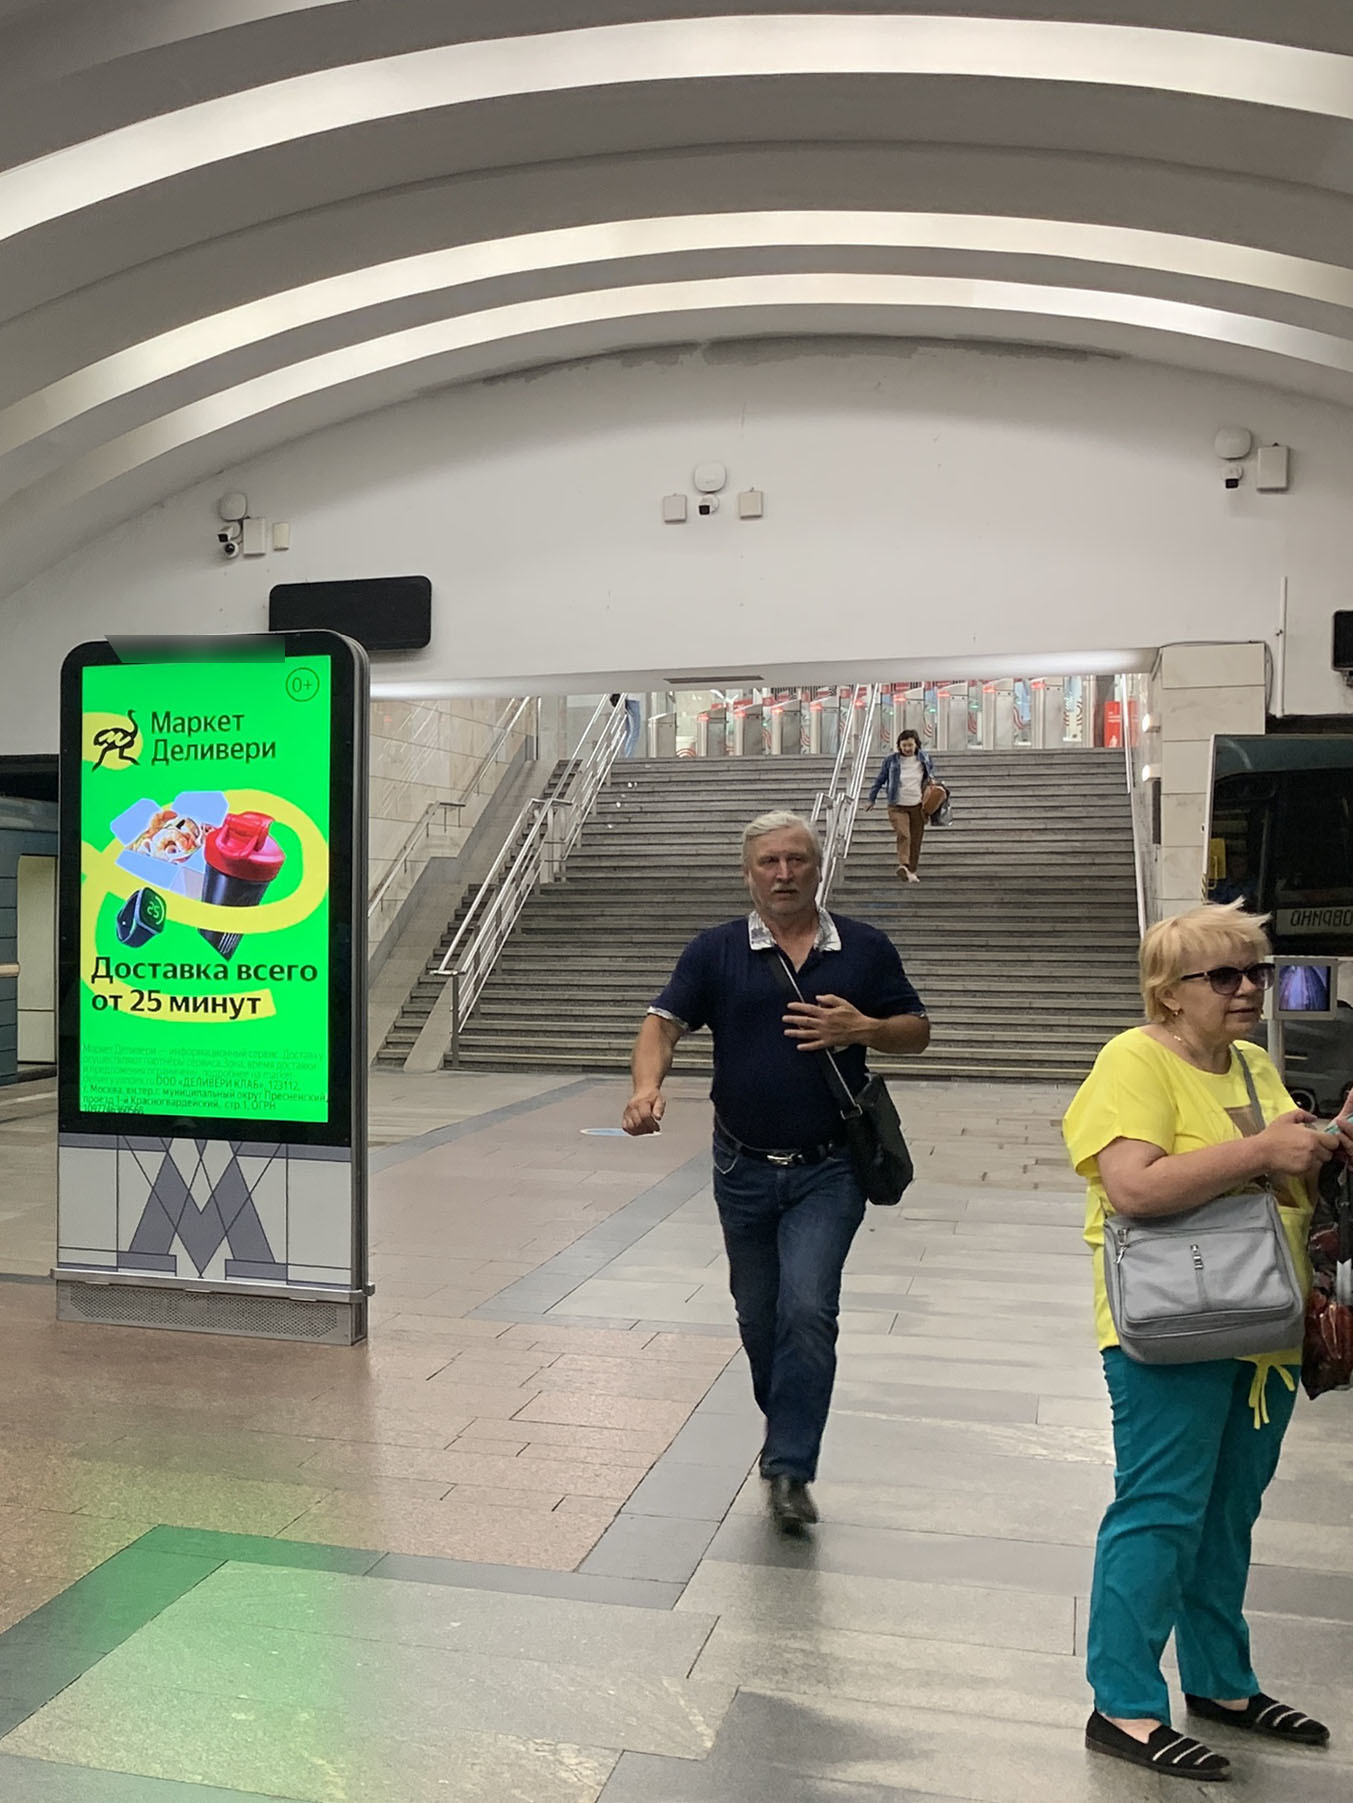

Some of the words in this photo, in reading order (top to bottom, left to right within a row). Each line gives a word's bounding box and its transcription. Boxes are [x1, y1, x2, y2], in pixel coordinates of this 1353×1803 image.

[291, 676, 313, 693] 0+
[151, 711, 245, 737] Маркет
[151, 738, 276, 766] Деливери
[91, 957, 229, 984] Доставка
[237, 964, 318, 981] всего
[91, 994, 123, 1011] от
[130, 989, 162, 1012] 25
[169, 996, 262, 1020] минут
